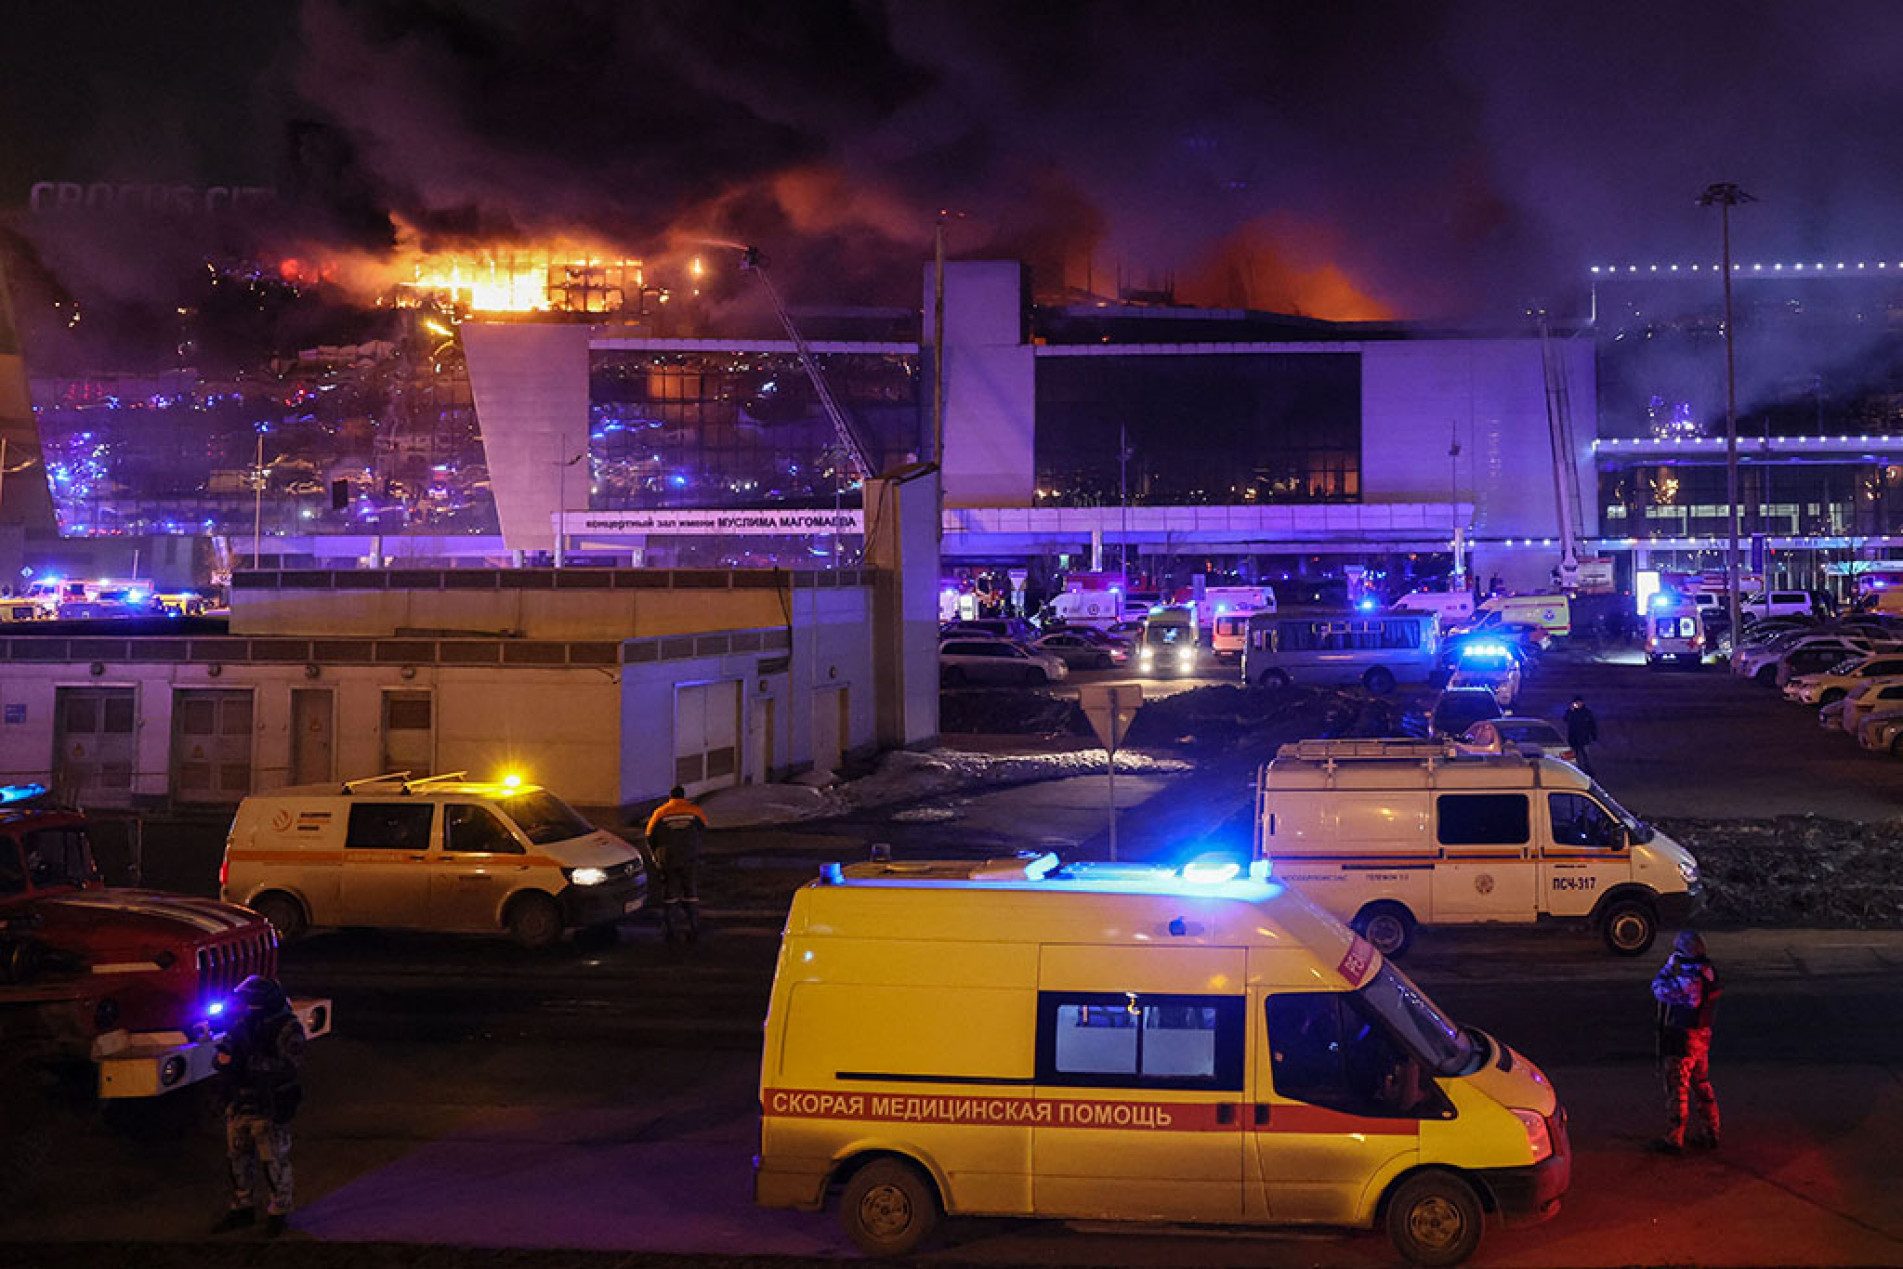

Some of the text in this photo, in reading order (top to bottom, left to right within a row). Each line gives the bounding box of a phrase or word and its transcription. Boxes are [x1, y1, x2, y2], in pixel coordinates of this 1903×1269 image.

[657, 520, 676, 528] зал
[717, 517, 777, 528] МУСЛИМА
[1553, 876, 1596, 890] ПСЧ-317
[772, 1092, 1172, 1128] СКОРАЯ МЕДИЦИНСКАЯ ПОМОЩЬ
